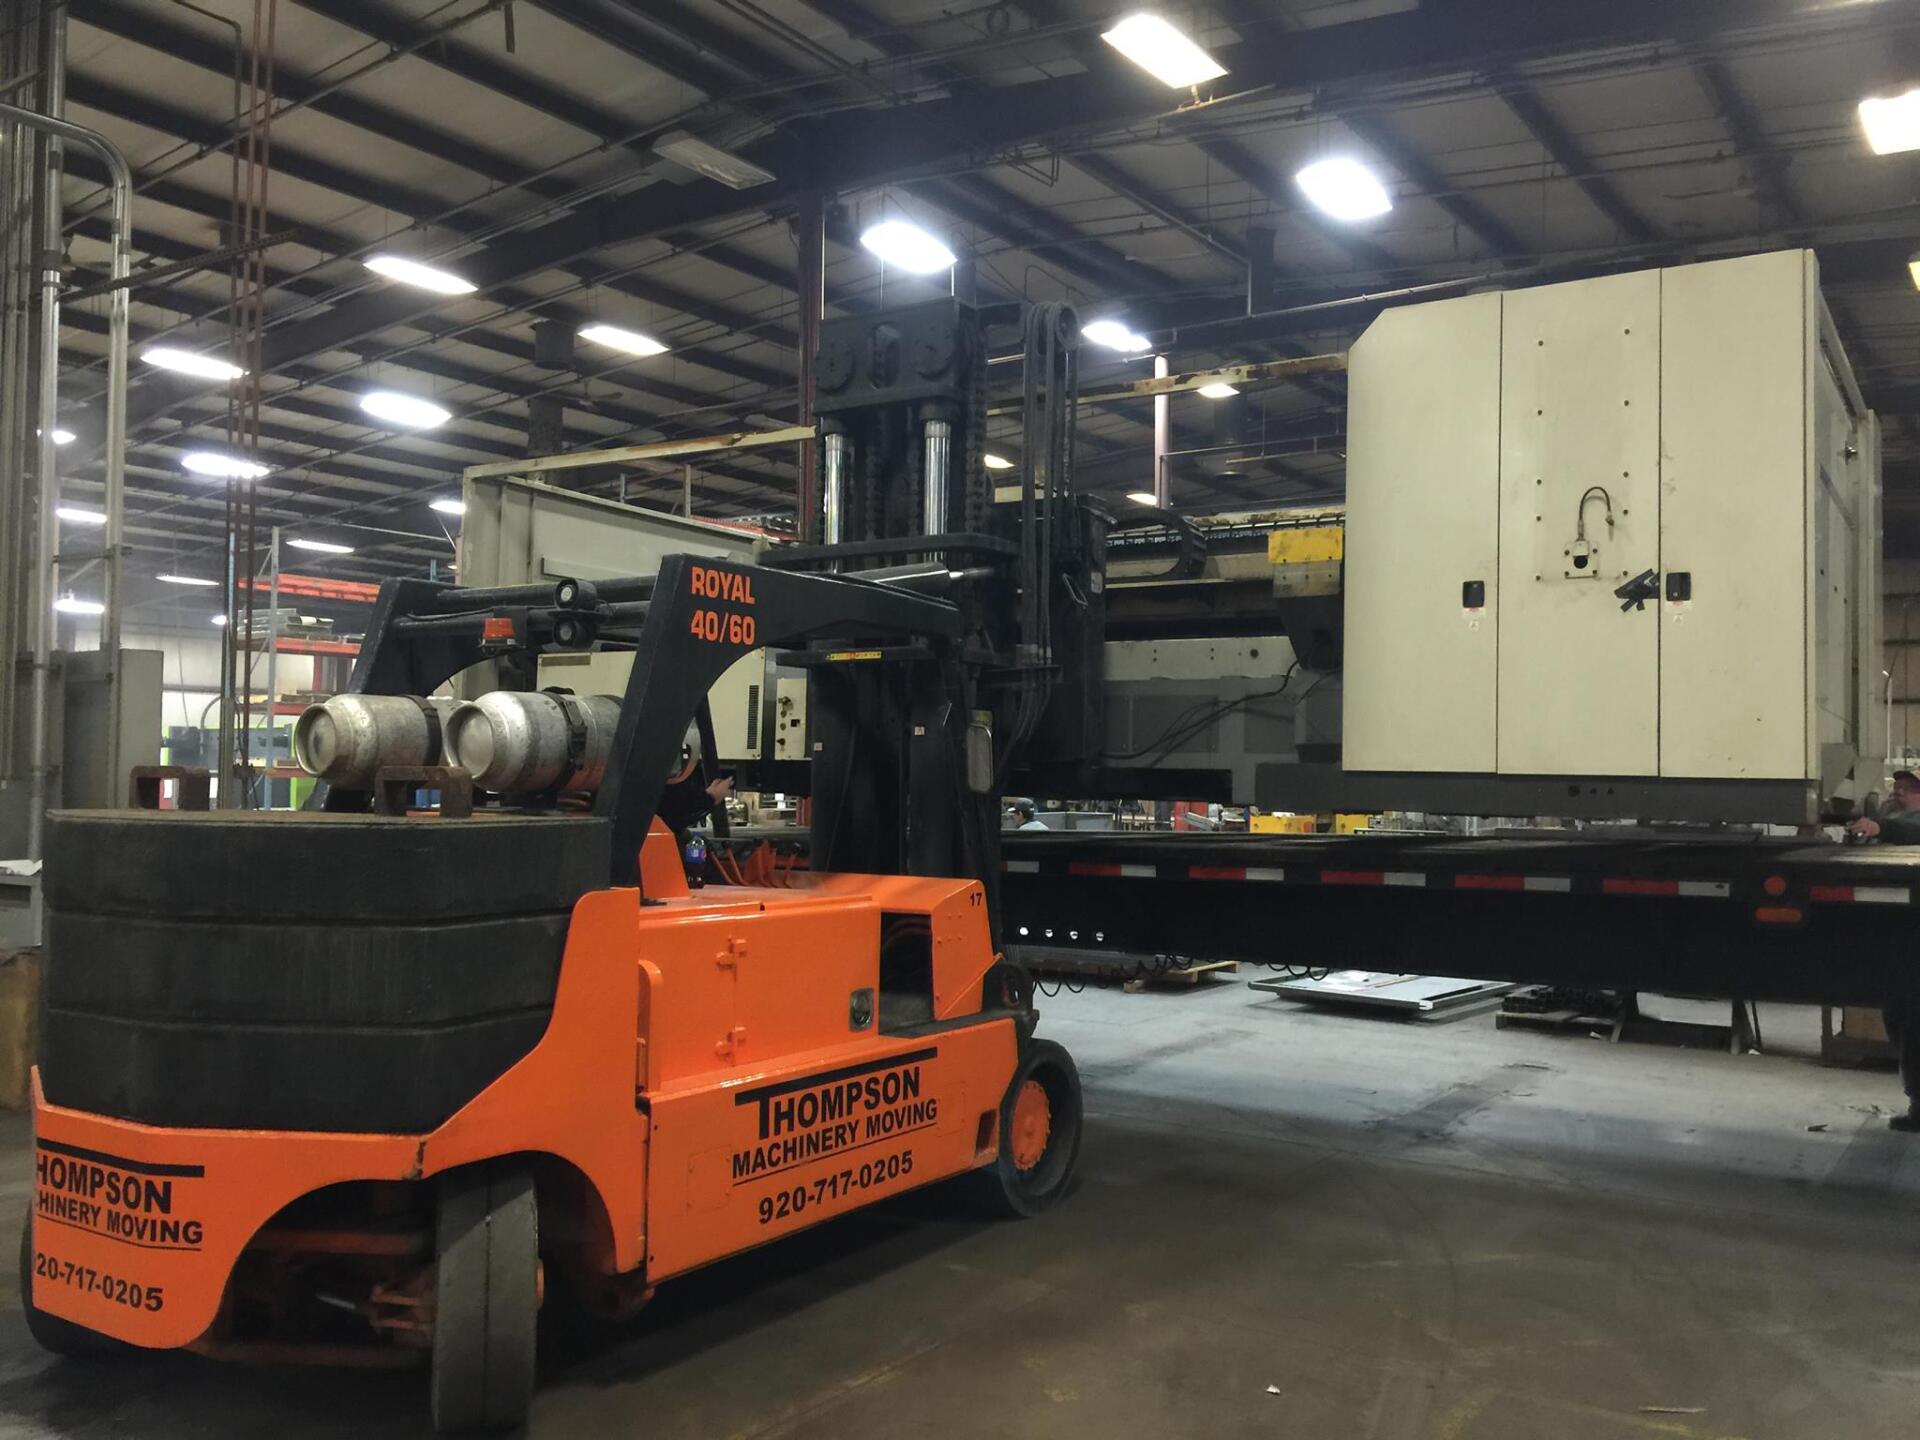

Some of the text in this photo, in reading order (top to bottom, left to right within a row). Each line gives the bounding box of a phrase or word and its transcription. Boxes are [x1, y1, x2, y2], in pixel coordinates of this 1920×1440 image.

[690, 566, 755, 604] ROYAL
[690, 609, 755, 645] 40/60
[970, 892, 982, 907] 17
[735, 1046, 938, 1140] THOMPSON
[732, 1098, 937, 1179] MACHINERY MOVING
[36, 1137, 204, 1214] HOMPSON
[759, 1150, 913, 1224] 920-717-0205
[36, 1190, 203, 1244] HINERY MOVING
[34, 1252, 164, 1312] 20-717-0205
